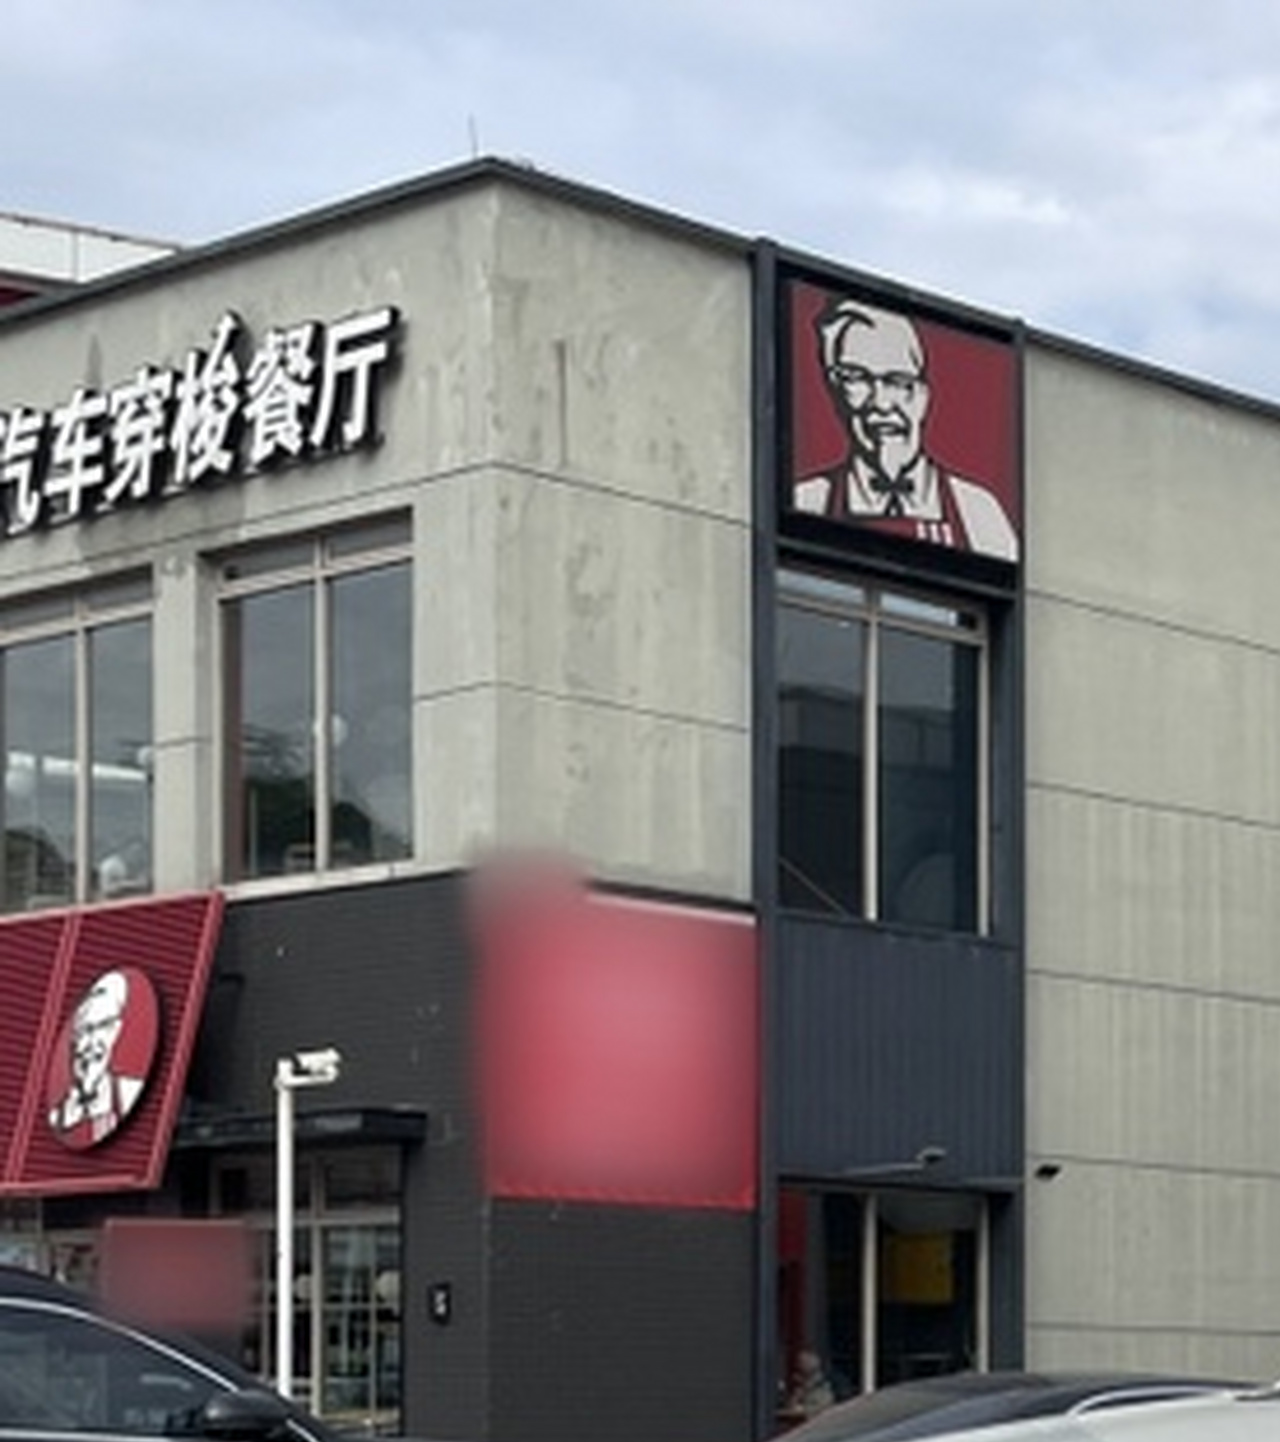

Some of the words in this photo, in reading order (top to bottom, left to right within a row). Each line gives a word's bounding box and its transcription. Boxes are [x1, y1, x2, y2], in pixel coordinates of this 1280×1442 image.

[0, 307, 394, 535] 汽车穿梭餐厅
